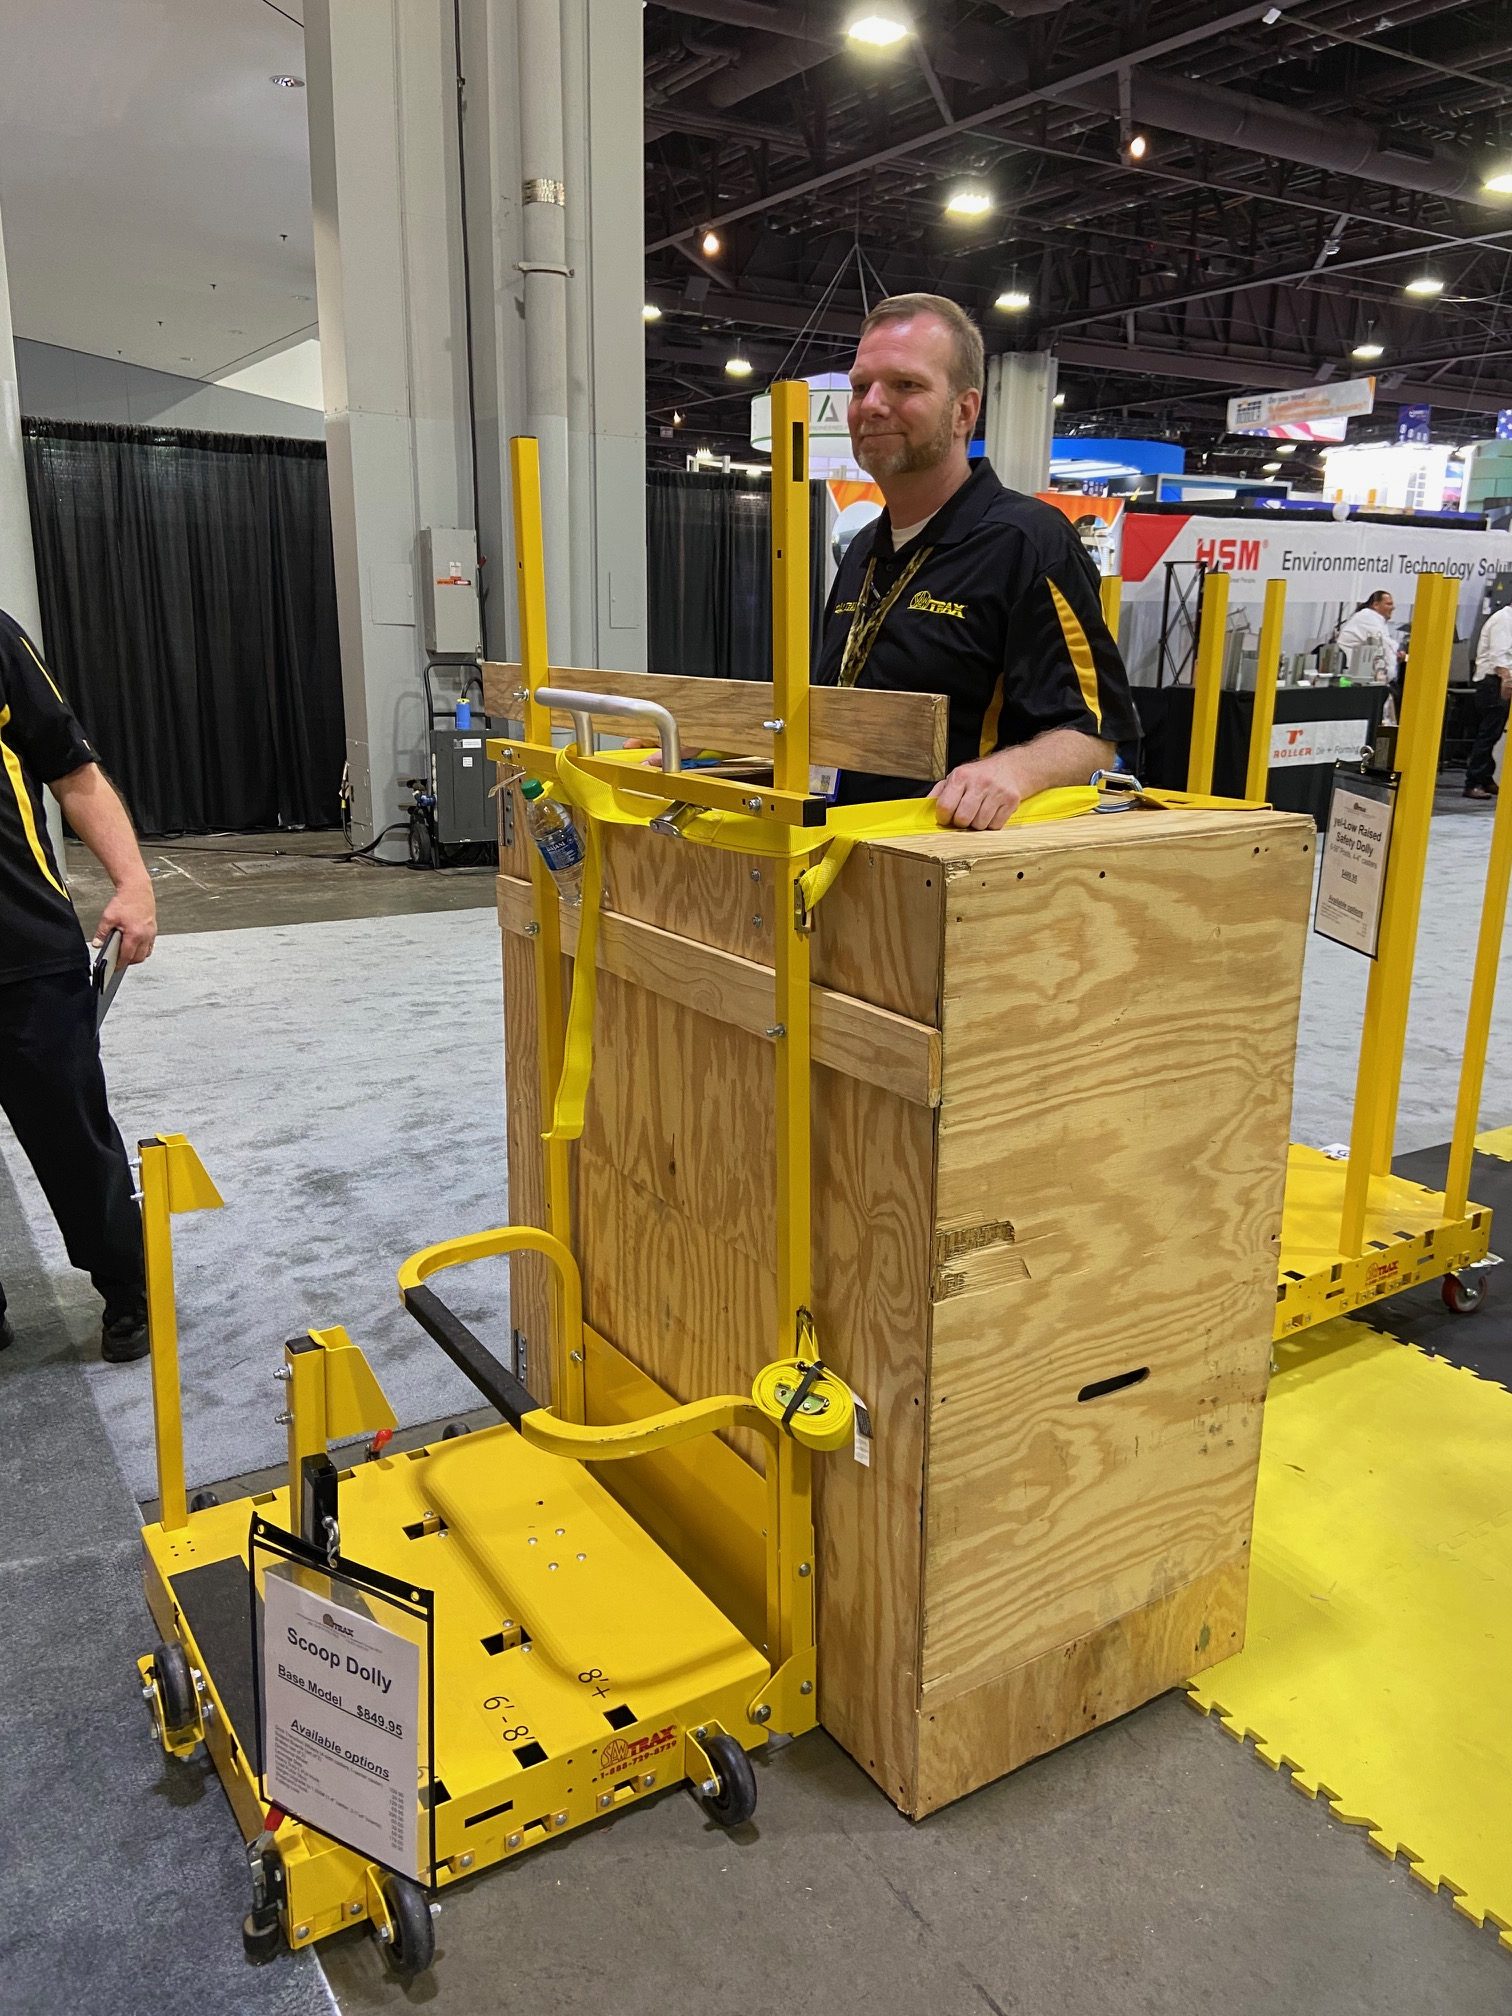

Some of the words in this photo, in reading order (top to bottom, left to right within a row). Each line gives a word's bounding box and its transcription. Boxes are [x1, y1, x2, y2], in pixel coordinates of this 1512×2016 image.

[1196, 538, 1261, 571] HSM
[1282, 550, 1394, 574] Environmental
[1399, 554, 1475, 581] Technology
[1274, 747, 1312, 759] ROLLER
[1336, 831, 1356, 850] Safety
[1356, 839, 1374, 858] Dolly
[1358, 824, 1382, 842] Raised
[287, 1627, 341, 1669] Scoop
[346, 1655, 392, 1694] Dolly
[278, 1663, 305, 1687] Base
[308, 1680, 342, 1707] Model
[356, 1704, 403, 1737] $849.95
[290, 1719, 342, 1754] Available
[344, 1750, 390, 1779] options
